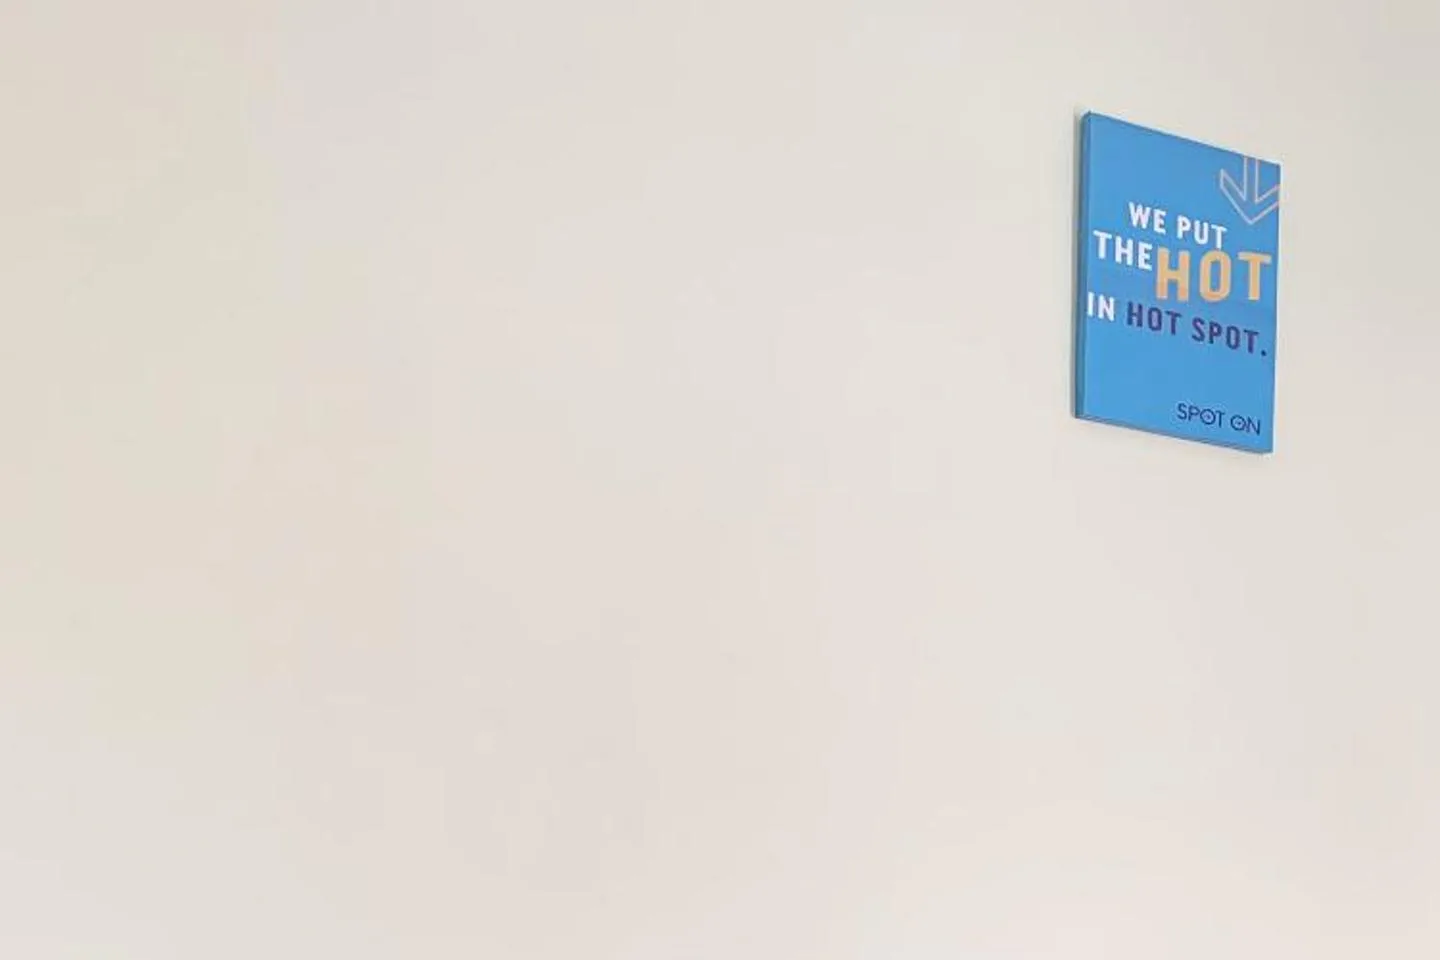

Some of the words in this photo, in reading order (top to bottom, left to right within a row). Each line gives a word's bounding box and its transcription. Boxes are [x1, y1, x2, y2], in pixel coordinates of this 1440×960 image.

[1128, 201, 1166, 234] WE
[1176, 215, 1228, 250] PUT
[1092, 229, 1153, 271] THE
[1155, 247, 1273, 303] HOT
[1087, 291, 1115, 322] IN
[1126, 301, 1182, 336] HOT
[1191, 317, 1268, 357] SPOT.
[1176, 403, 1226, 430] SPOT
[1230, 413, 1261, 436] ON
